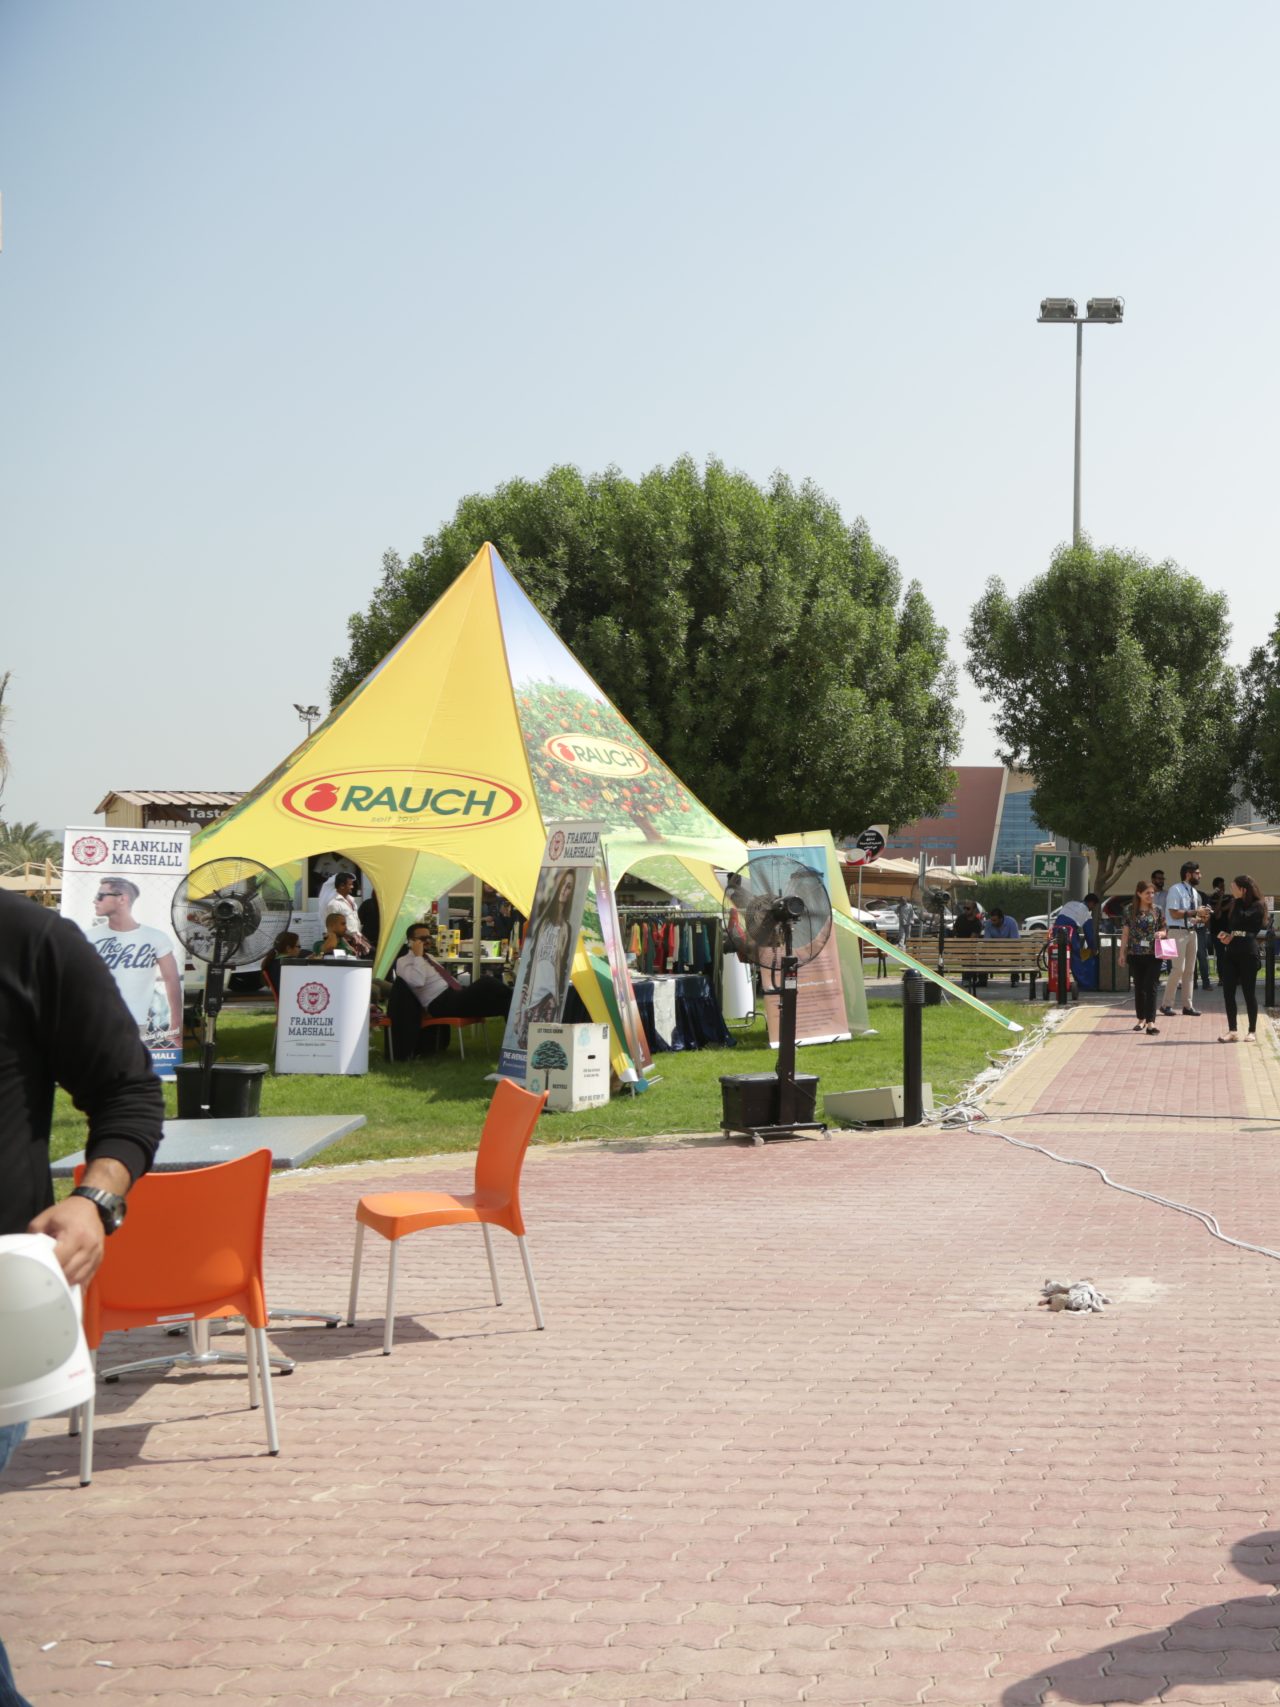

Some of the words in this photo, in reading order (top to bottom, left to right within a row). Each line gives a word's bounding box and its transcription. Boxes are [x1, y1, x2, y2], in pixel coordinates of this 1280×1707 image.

[571, 744, 641, 769] RAUCH
[340, 785, 497, 817] RAUCH
[567, 831, 600, 844] FRANKLIN
[112, 839, 183, 854] FRANKLIN
[563, 846, 596, 859] MARSHALL
[111, 853, 182, 867] MARSHALL
[95, 936, 122, 954] The
[290, 1017, 334, 1026] FRANKLIN
[288, 1027, 335, 1037] MARSHALL
[152, 1052, 177, 1060] MALL
